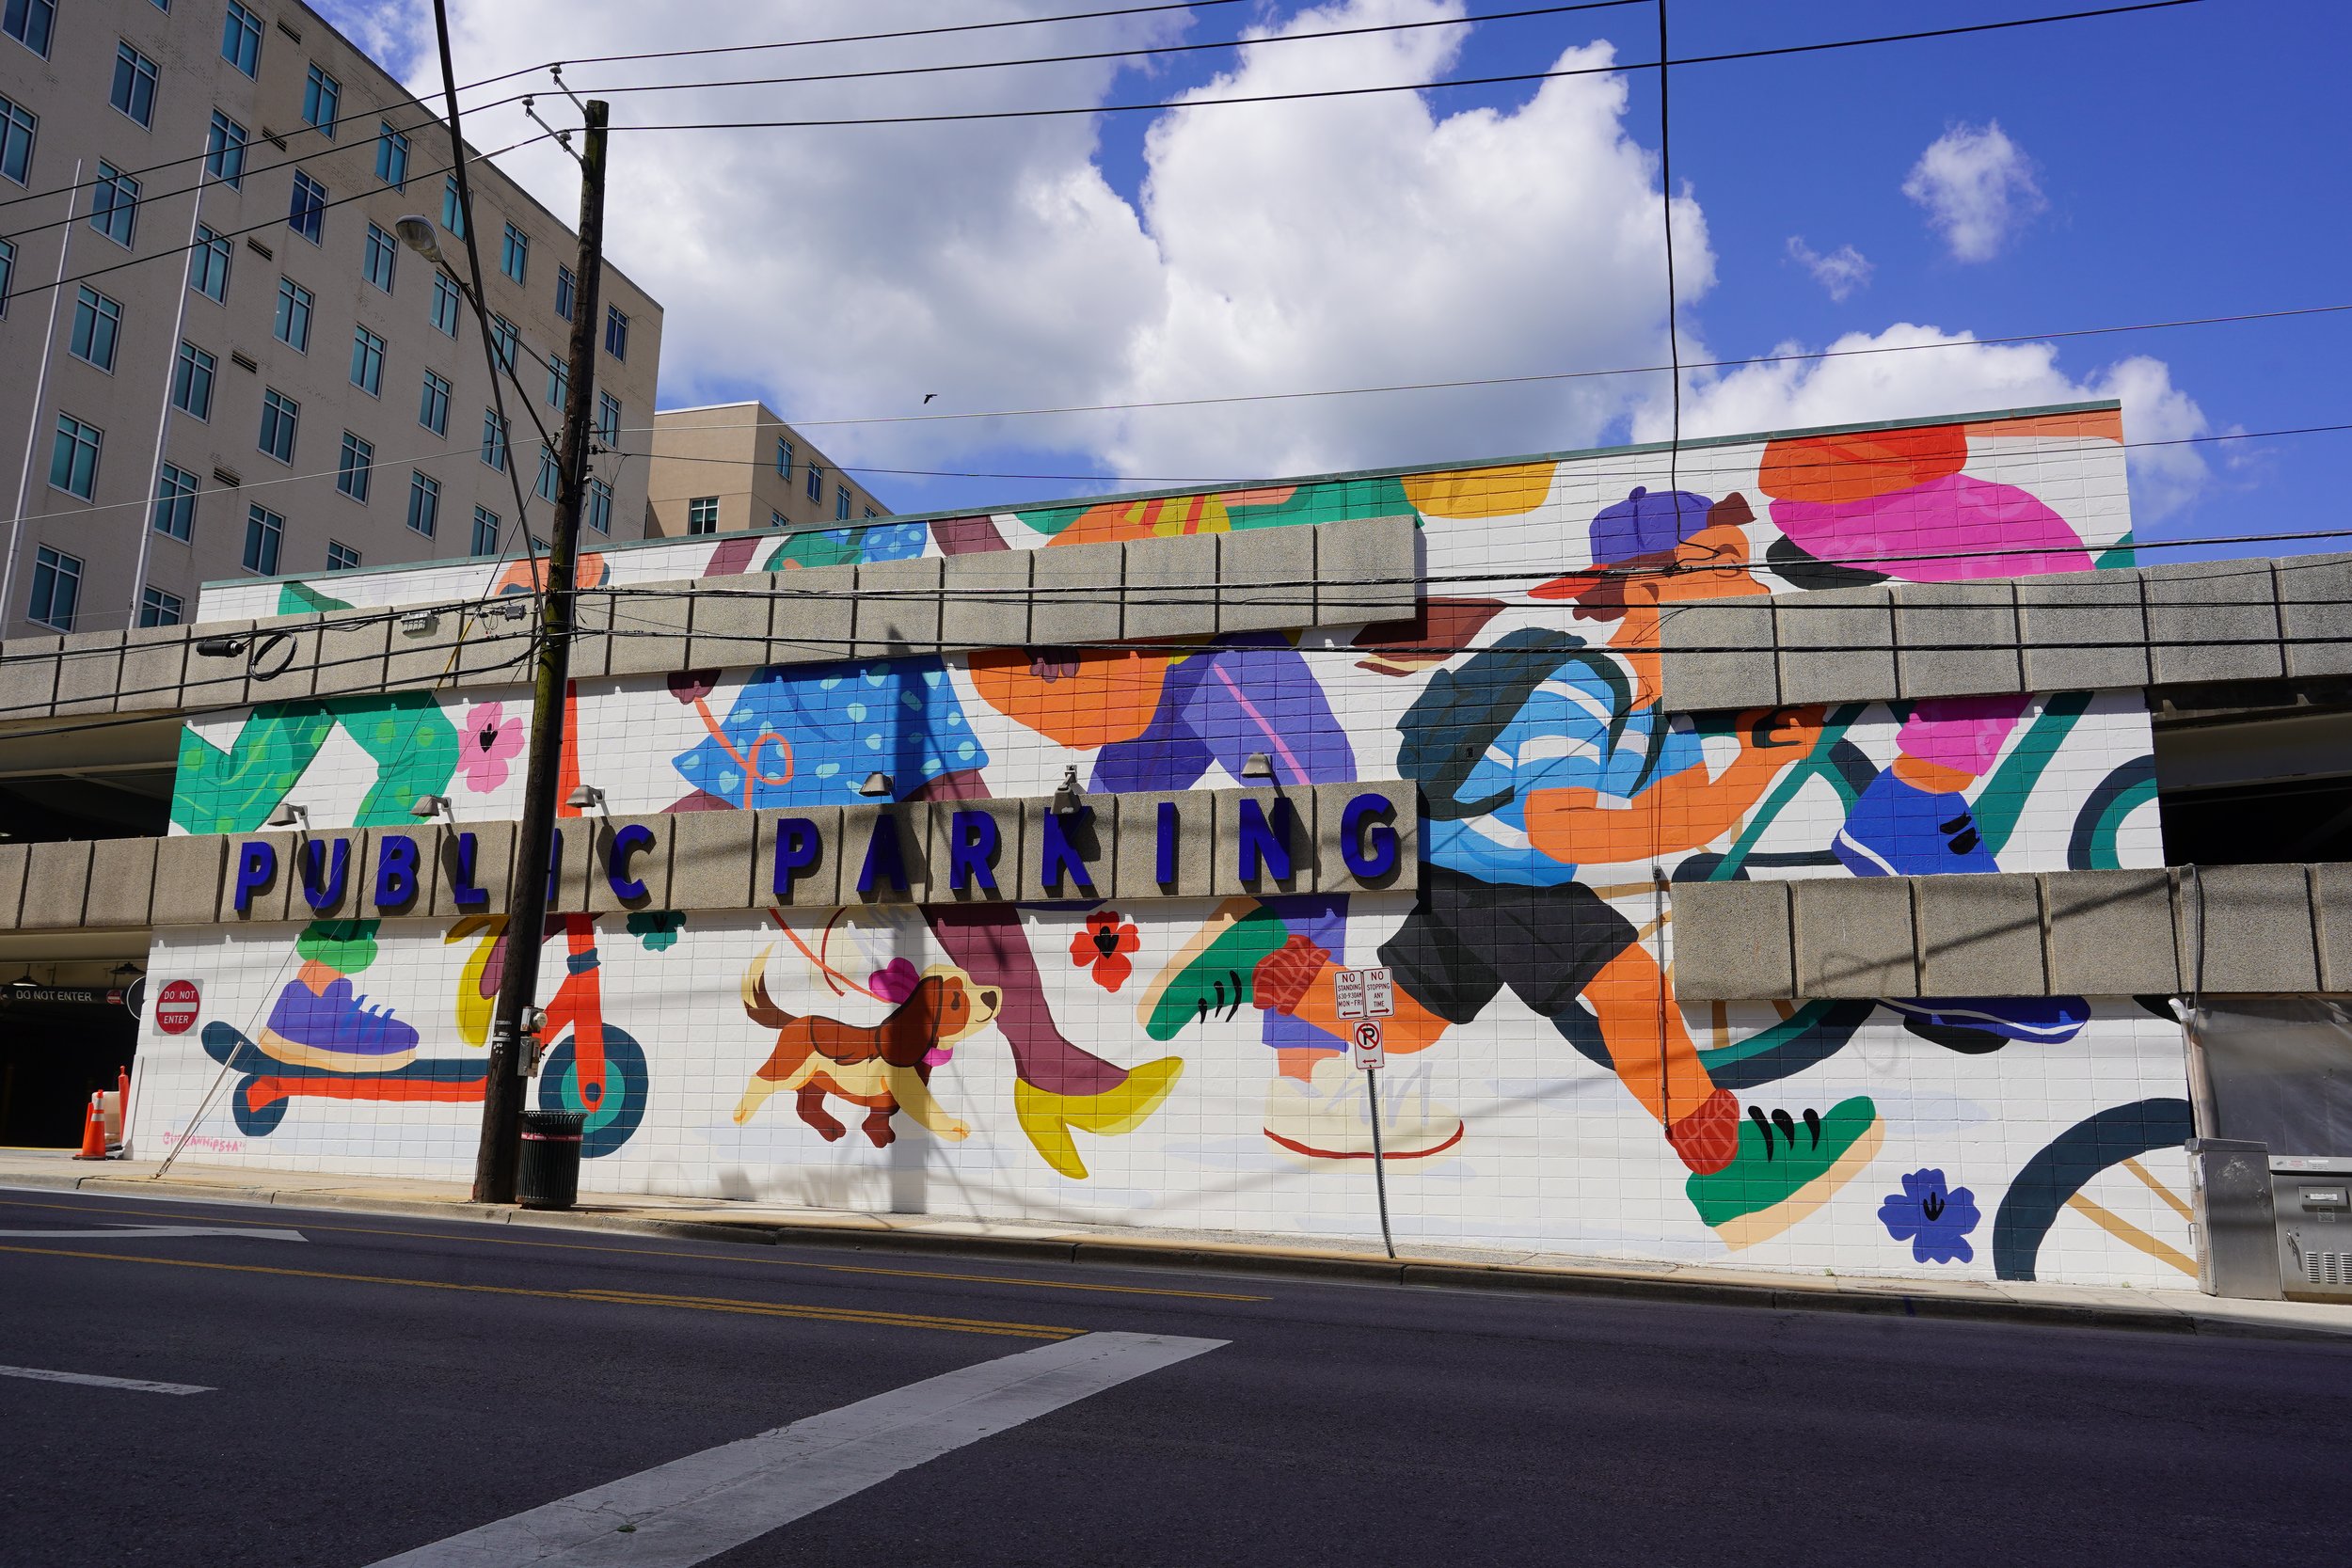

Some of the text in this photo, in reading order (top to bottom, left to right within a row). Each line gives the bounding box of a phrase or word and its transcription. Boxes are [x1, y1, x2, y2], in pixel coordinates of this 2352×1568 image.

[773, 793, 1395, 895] PARKING
[1342, 974, 1355, 982] NO
[1371, 971, 1383, 980] NO
[16, 990, 92, 1002] DO NOT ENTER
[164, 990, 196, 1000] DO NOT
[164, 1015, 189, 1024] ENTER
